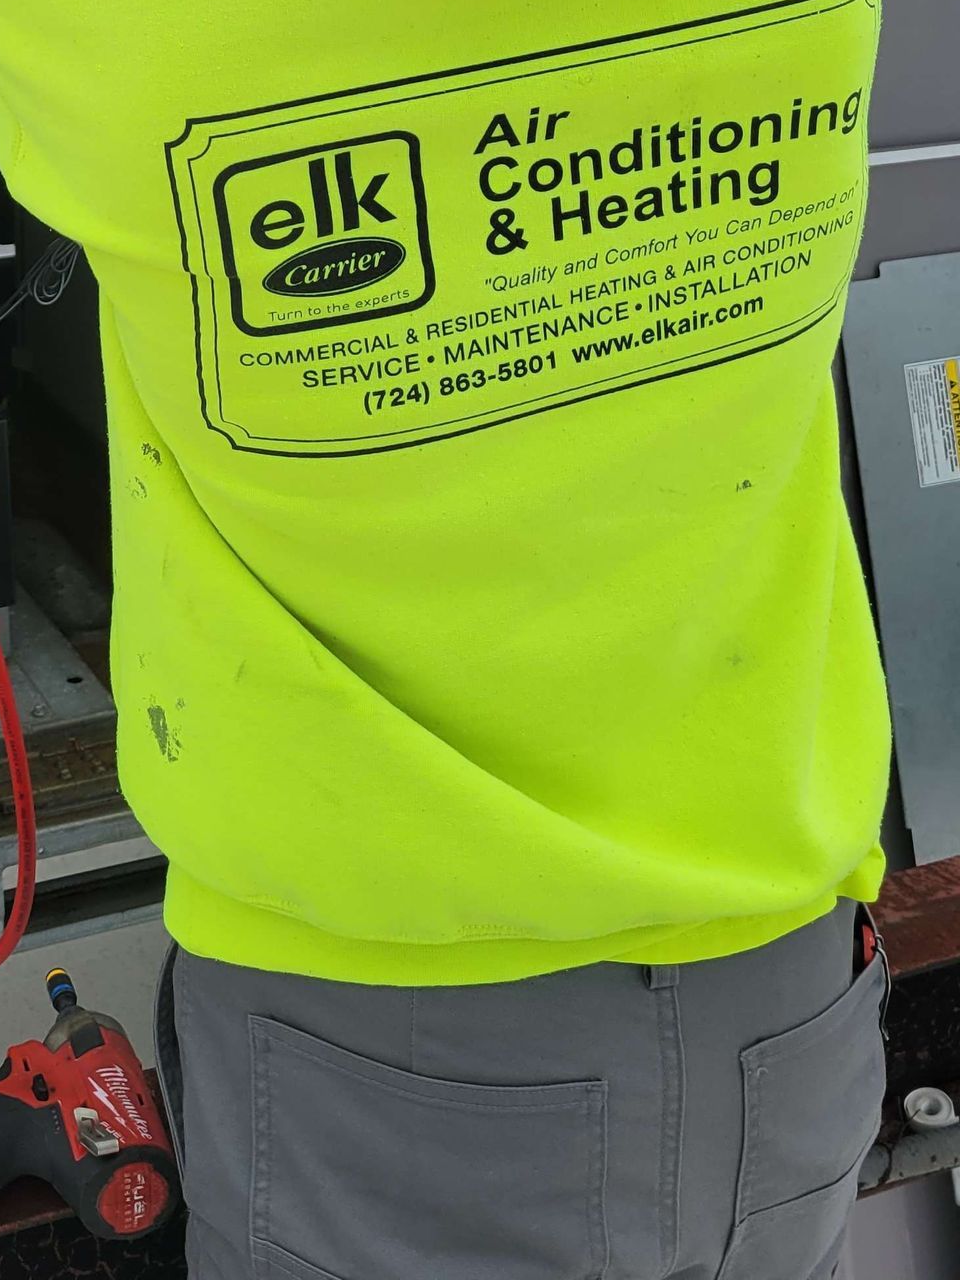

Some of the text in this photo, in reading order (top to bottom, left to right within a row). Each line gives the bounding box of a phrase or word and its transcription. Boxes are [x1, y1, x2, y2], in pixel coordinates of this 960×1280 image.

[474, 107, 570, 154] Air
[479, 84, 863, 202] Conditioning
[250, 151, 397, 250] elk
[486, 160, 779, 255] & Heating
[486, 266, 557, 291] "Quality
[564, 253, 598, 275] and
[606, 234, 678, 264] Comfort
[686, 228, 718, 244] You
[726, 218, 761, 234] Can
[769, 194, 836, 225] Depend
[240, 211, 852, 366] COMMERCIAL & RESIDENTIAL HEATING & AIR CONDITIONING
[269, 290, 409, 321] Turn to the experts
[284, 248, 387, 287] Carrier
[303, 250, 811, 388] SERVICE MAINTENANCE INSTALLATION
[364, 296, 763, 415] (724) 863-5801 www.elkair.com
[95, 1063, 153, 1141] Milwaukee
[100, 1121, 126, 1144] FUEL
